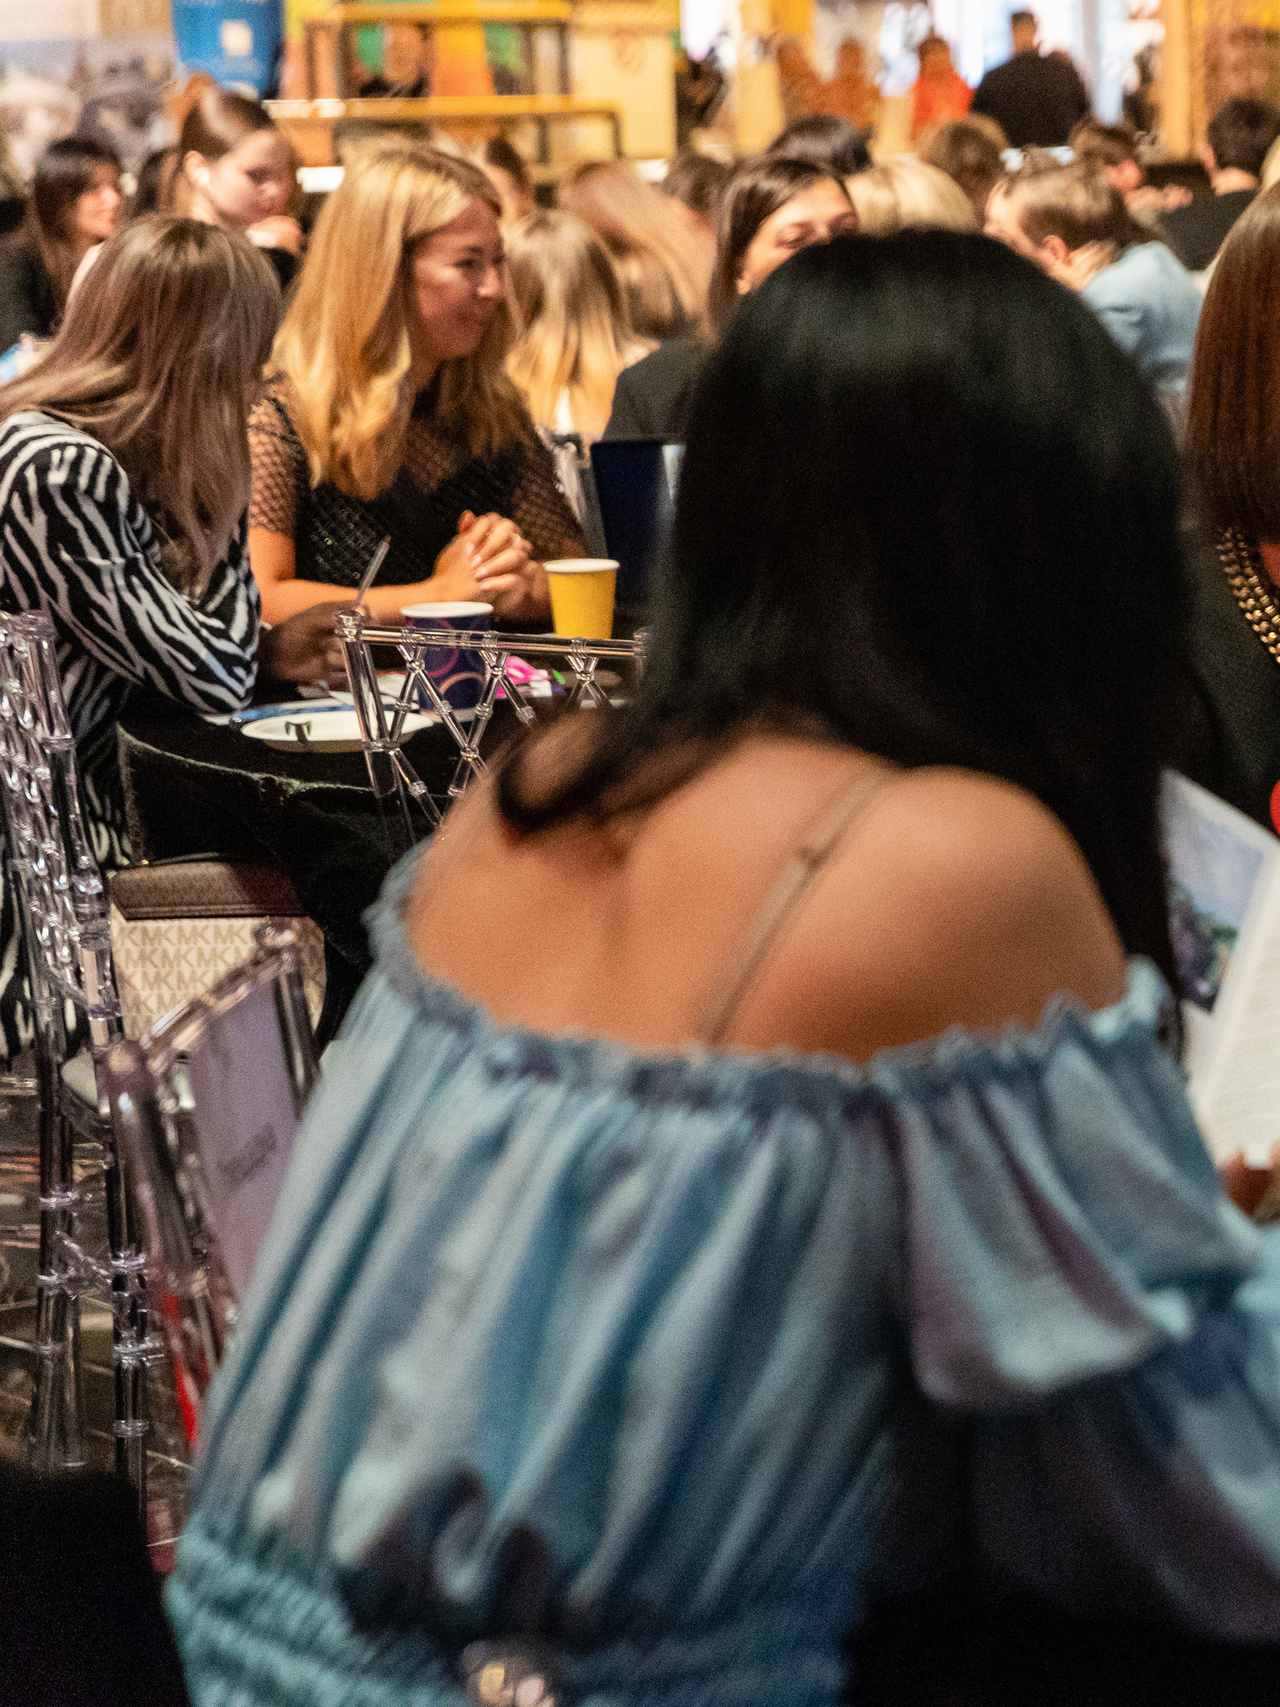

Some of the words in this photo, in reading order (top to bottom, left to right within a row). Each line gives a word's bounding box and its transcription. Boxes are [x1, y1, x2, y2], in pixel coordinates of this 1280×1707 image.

[141, 926, 174, 946] MK
[177, 925, 211, 945] MK
[213, 924, 248, 945] MK
[125, 948, 158, 969] MK
[161, 948, 195, 968] MK
[197, 947, 231, 968] MK
[141, 970, 174, 991] MK
[177, 970, 210, 991] MK
